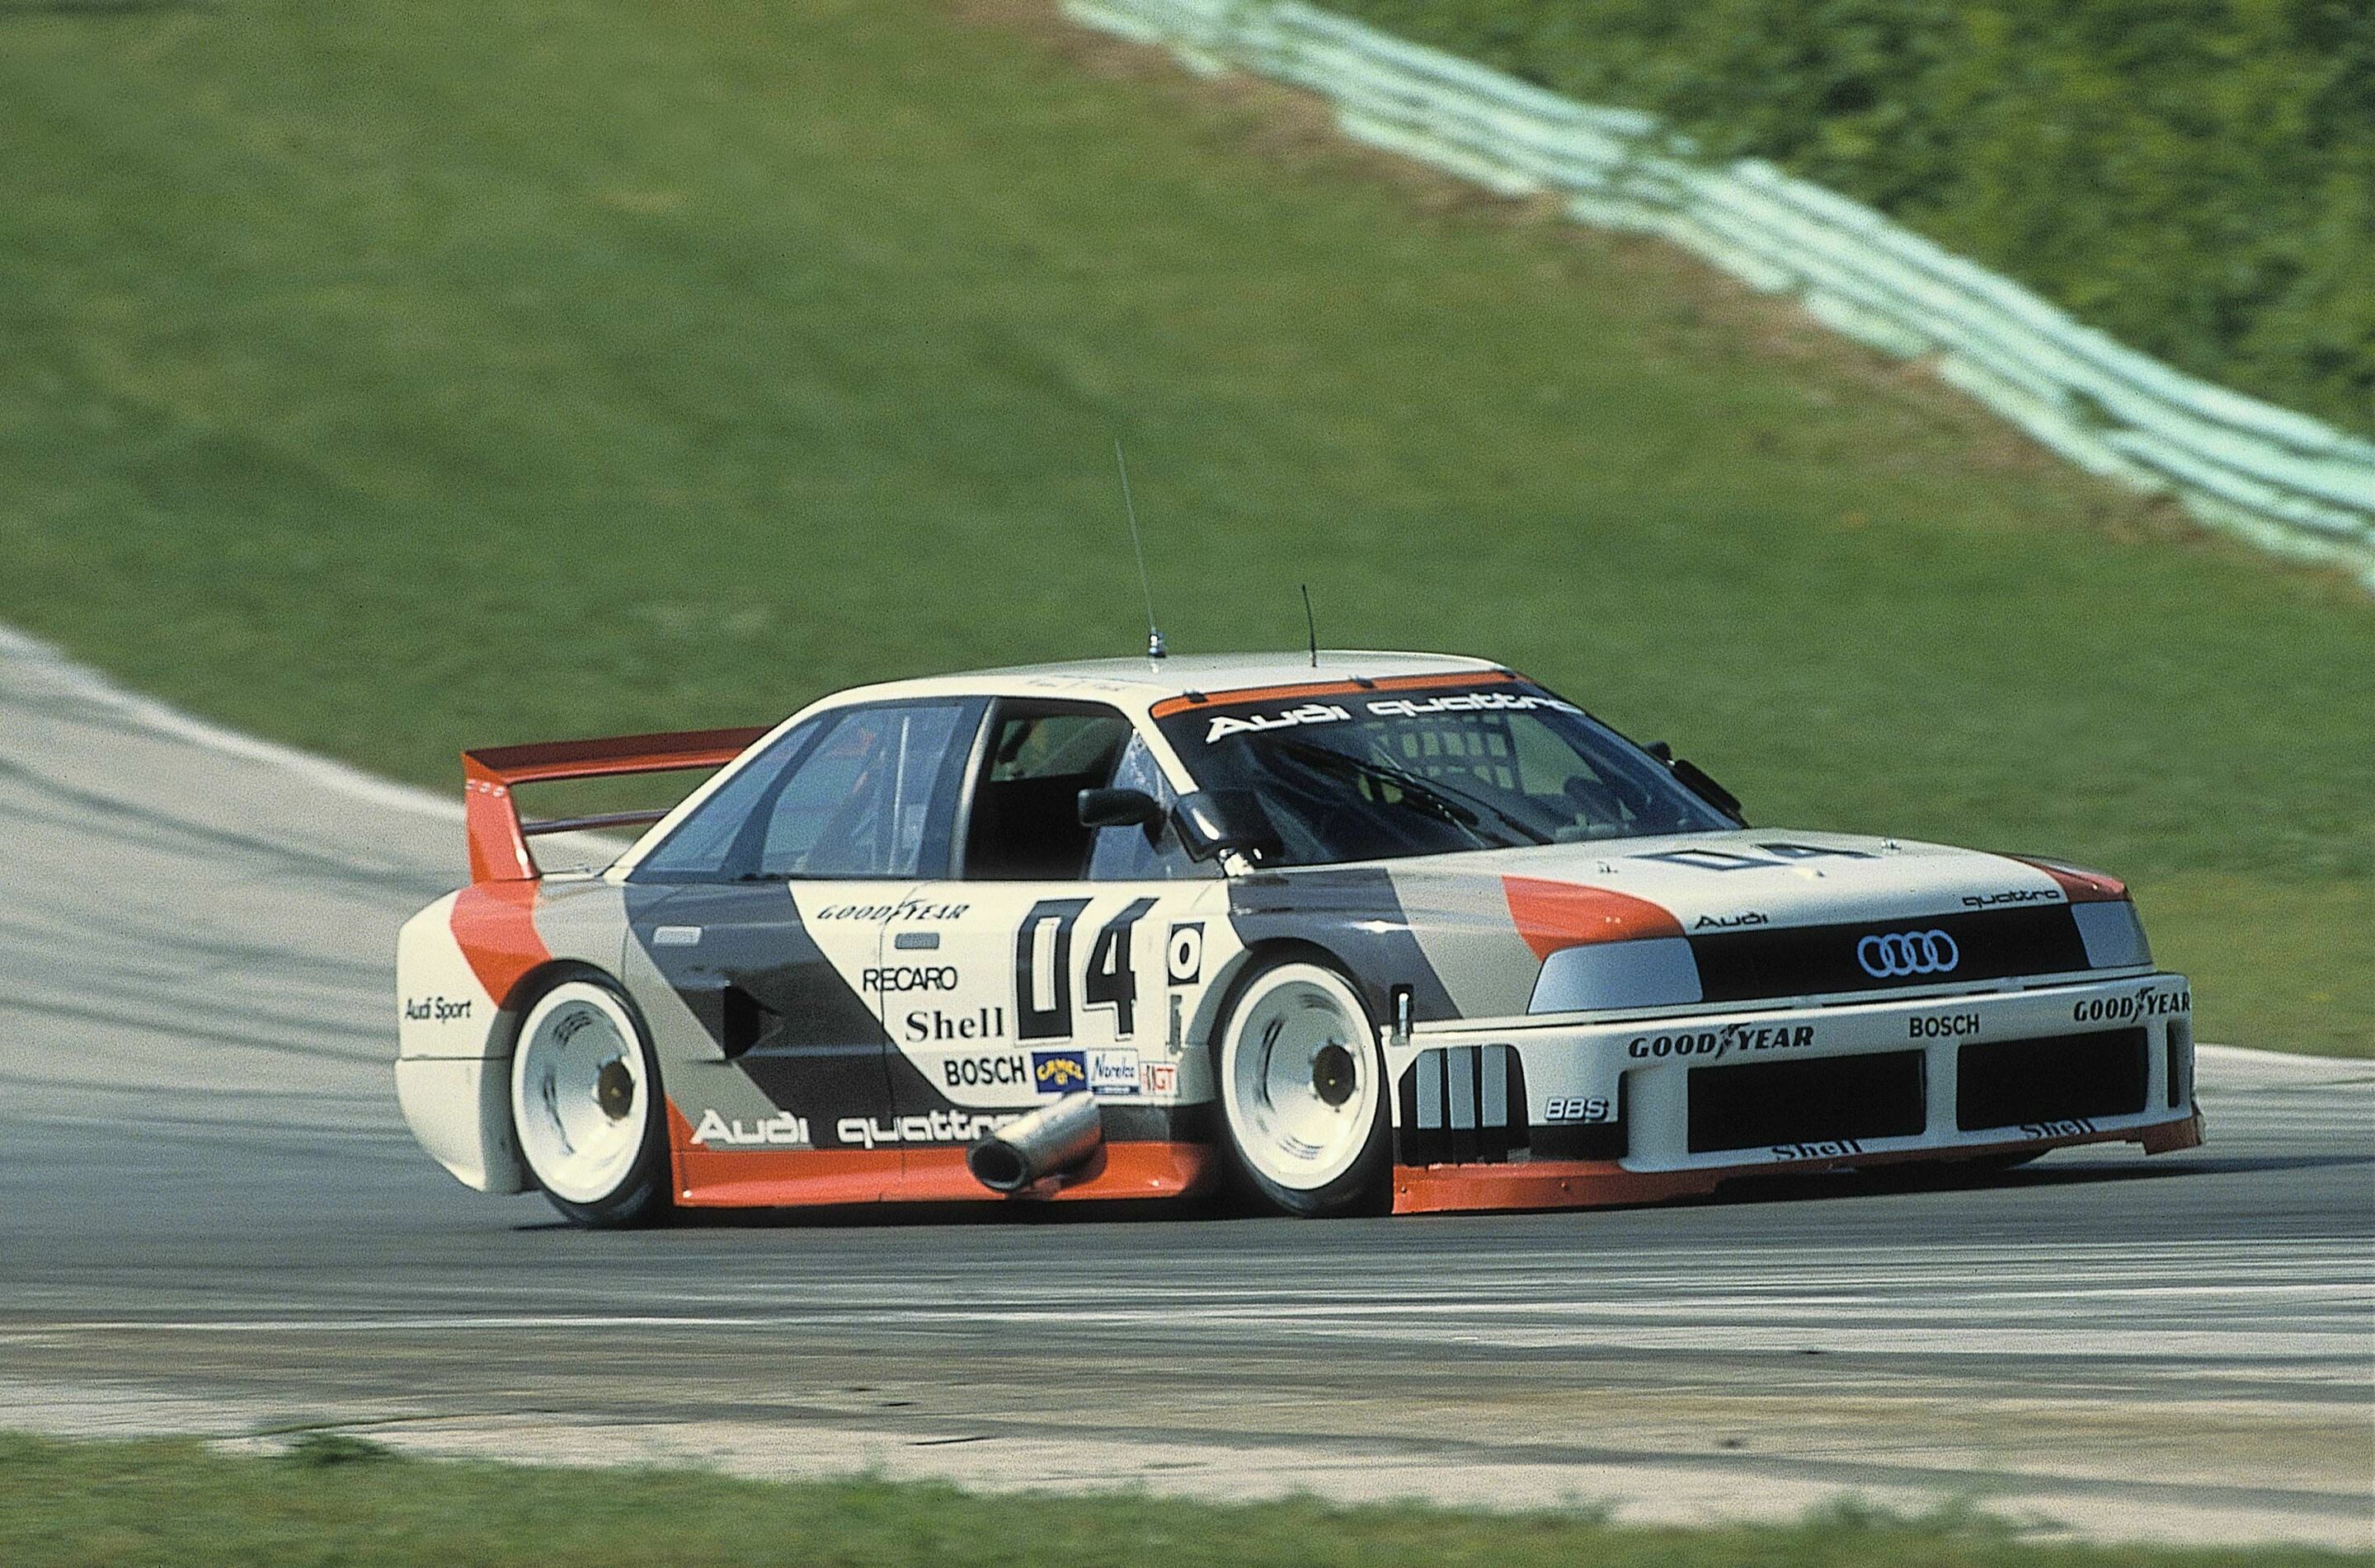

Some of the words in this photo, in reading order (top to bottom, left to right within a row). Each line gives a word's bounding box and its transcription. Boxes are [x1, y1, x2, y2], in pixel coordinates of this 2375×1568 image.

[1206, 702, 1352, 744] Audi
[1962, 889, 2060, 909] quattro
[1695, 913, 1769, 930] Audi
[863, 966, 957, 992] RECARO
[1014, 896, 1161, 1042] 04
[405, 997, 431, 1020] Audi
[434, 997, 472, 1024] Sport
[906, 1006, 1005, 1043] Shell
[1909, 1013, 1980, 1038] BOSCH
[1629, 1021, 1814, 1059] GOODYEAR
[944, 1056, 1027, 1087] BOSCH
[1544, 1096, 1608, 1121] BBS
[690, 1109, 808, 1144] Audi
[2021, 1118, 2097, 1139] Shell
[1773, 1138, 1863, 1162] Shell
